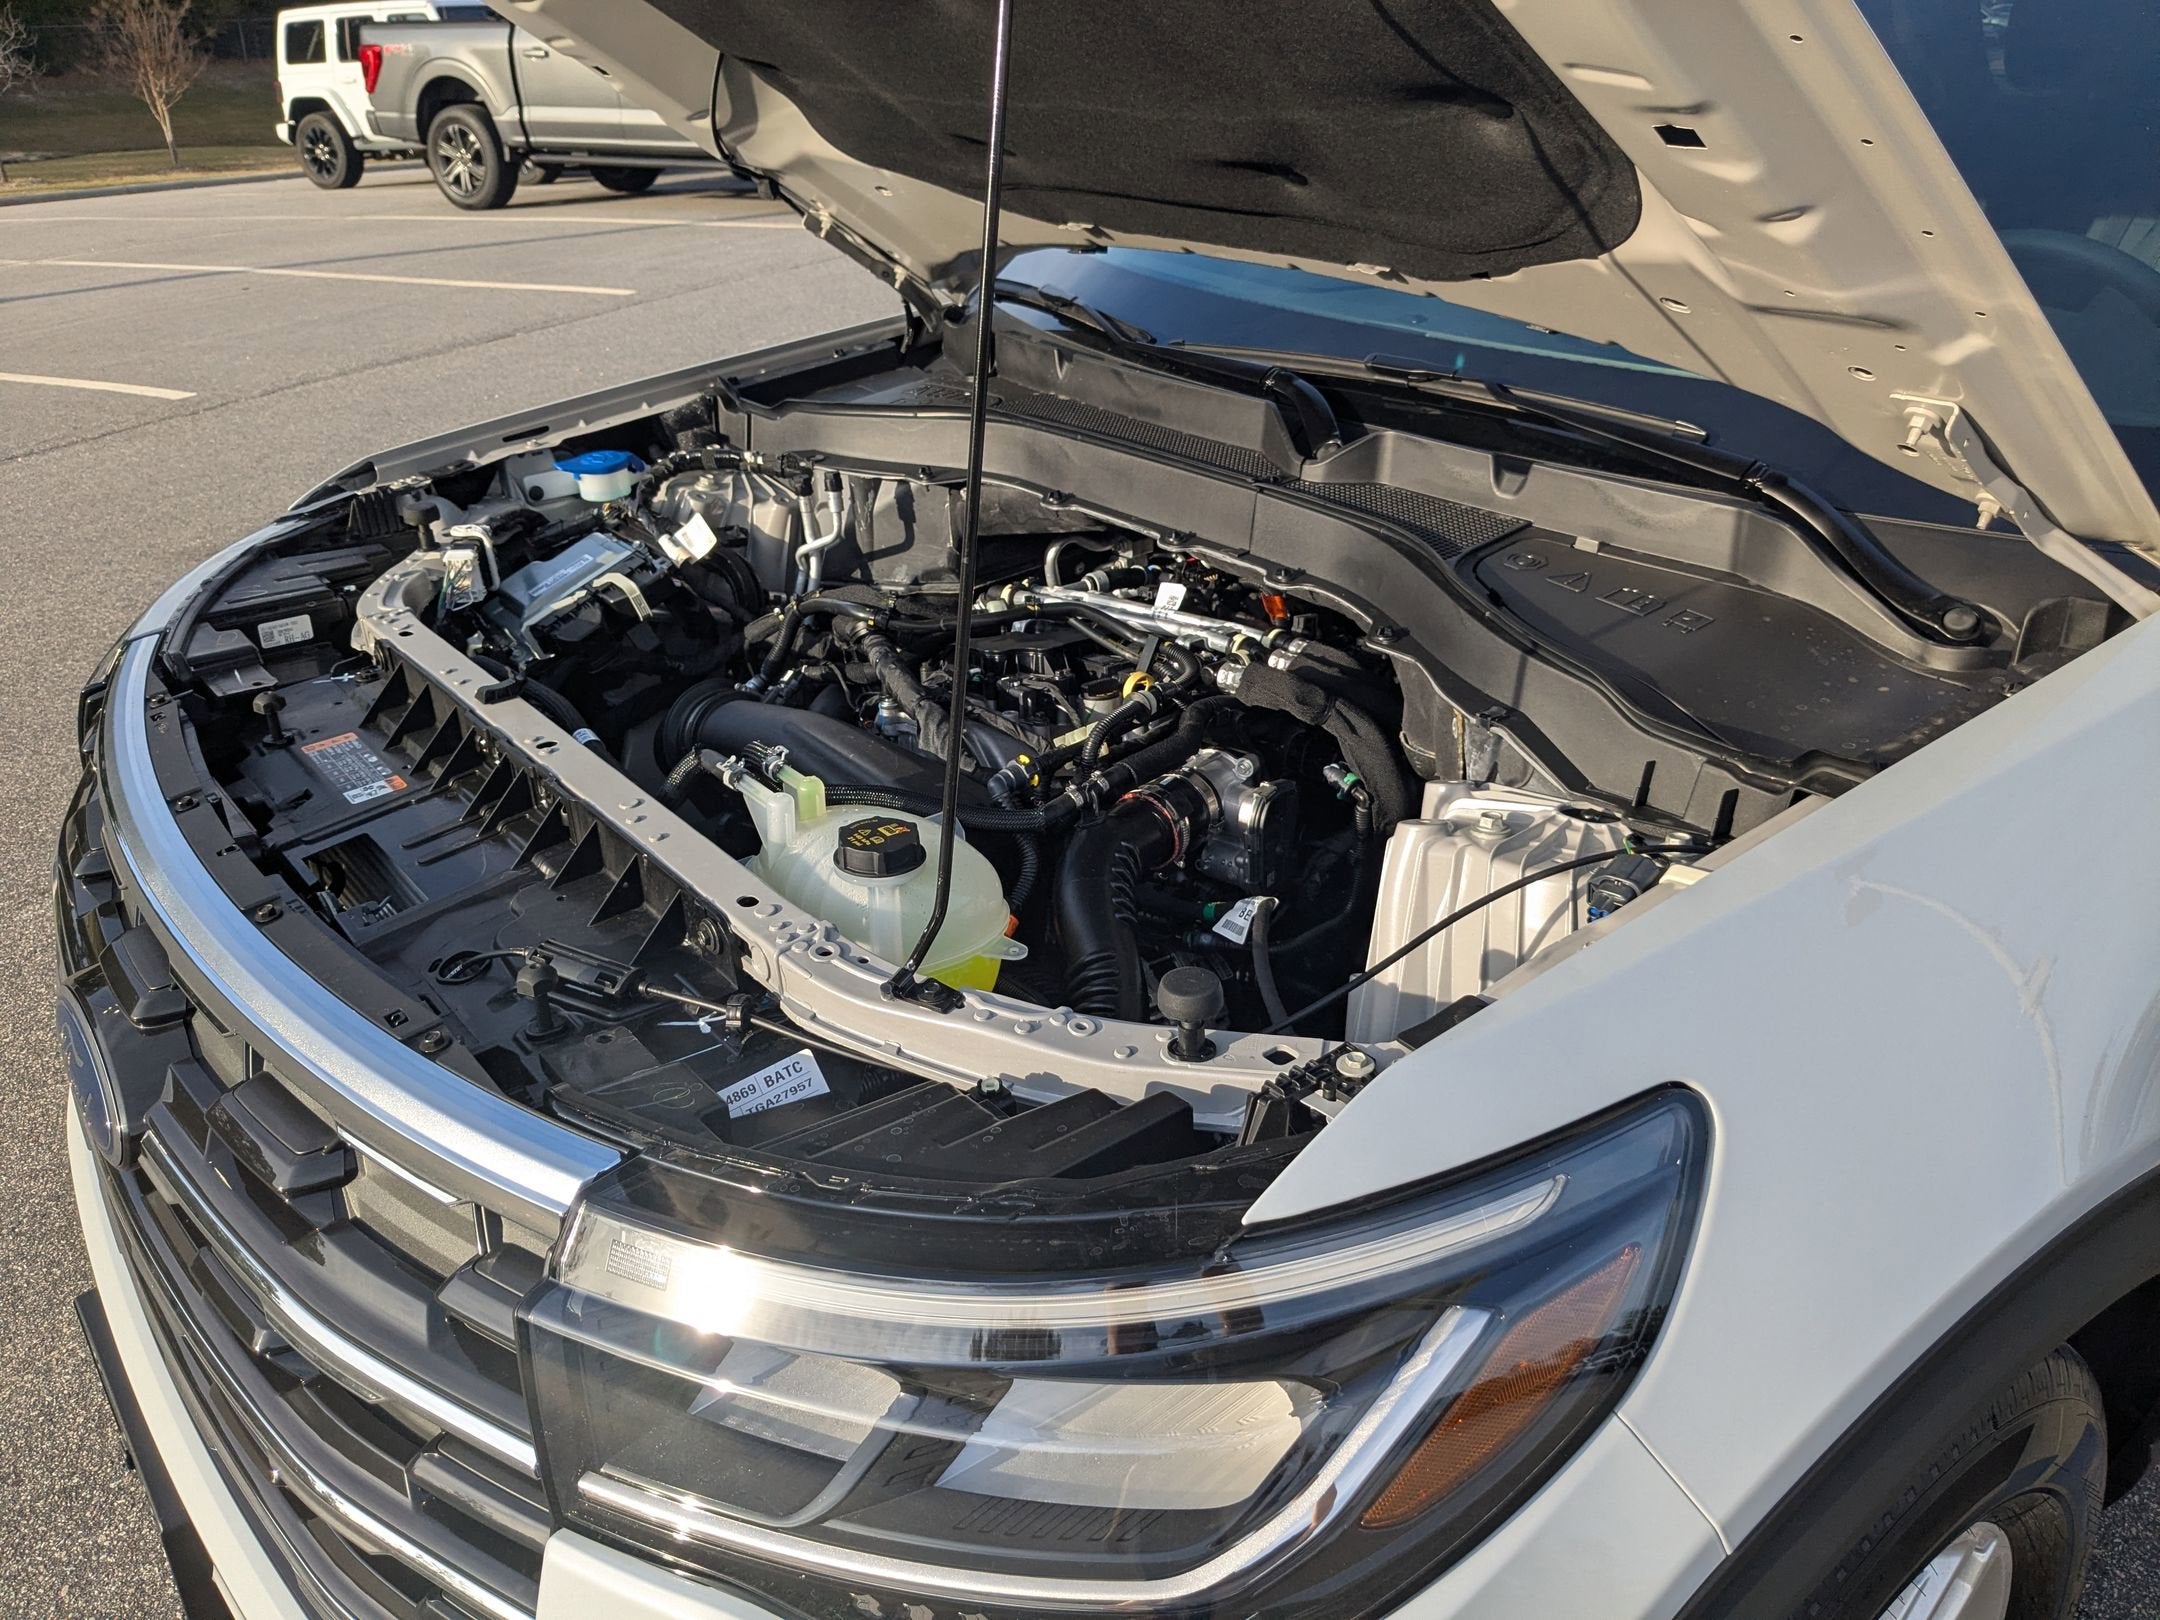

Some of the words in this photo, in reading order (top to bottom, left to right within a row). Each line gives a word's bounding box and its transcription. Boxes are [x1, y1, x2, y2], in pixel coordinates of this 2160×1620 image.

[726, 1083, 757, 1106] 4869
[763, 1060, 803, 1088] BATC
[745, 1077, 813, 1114] TGA27957
